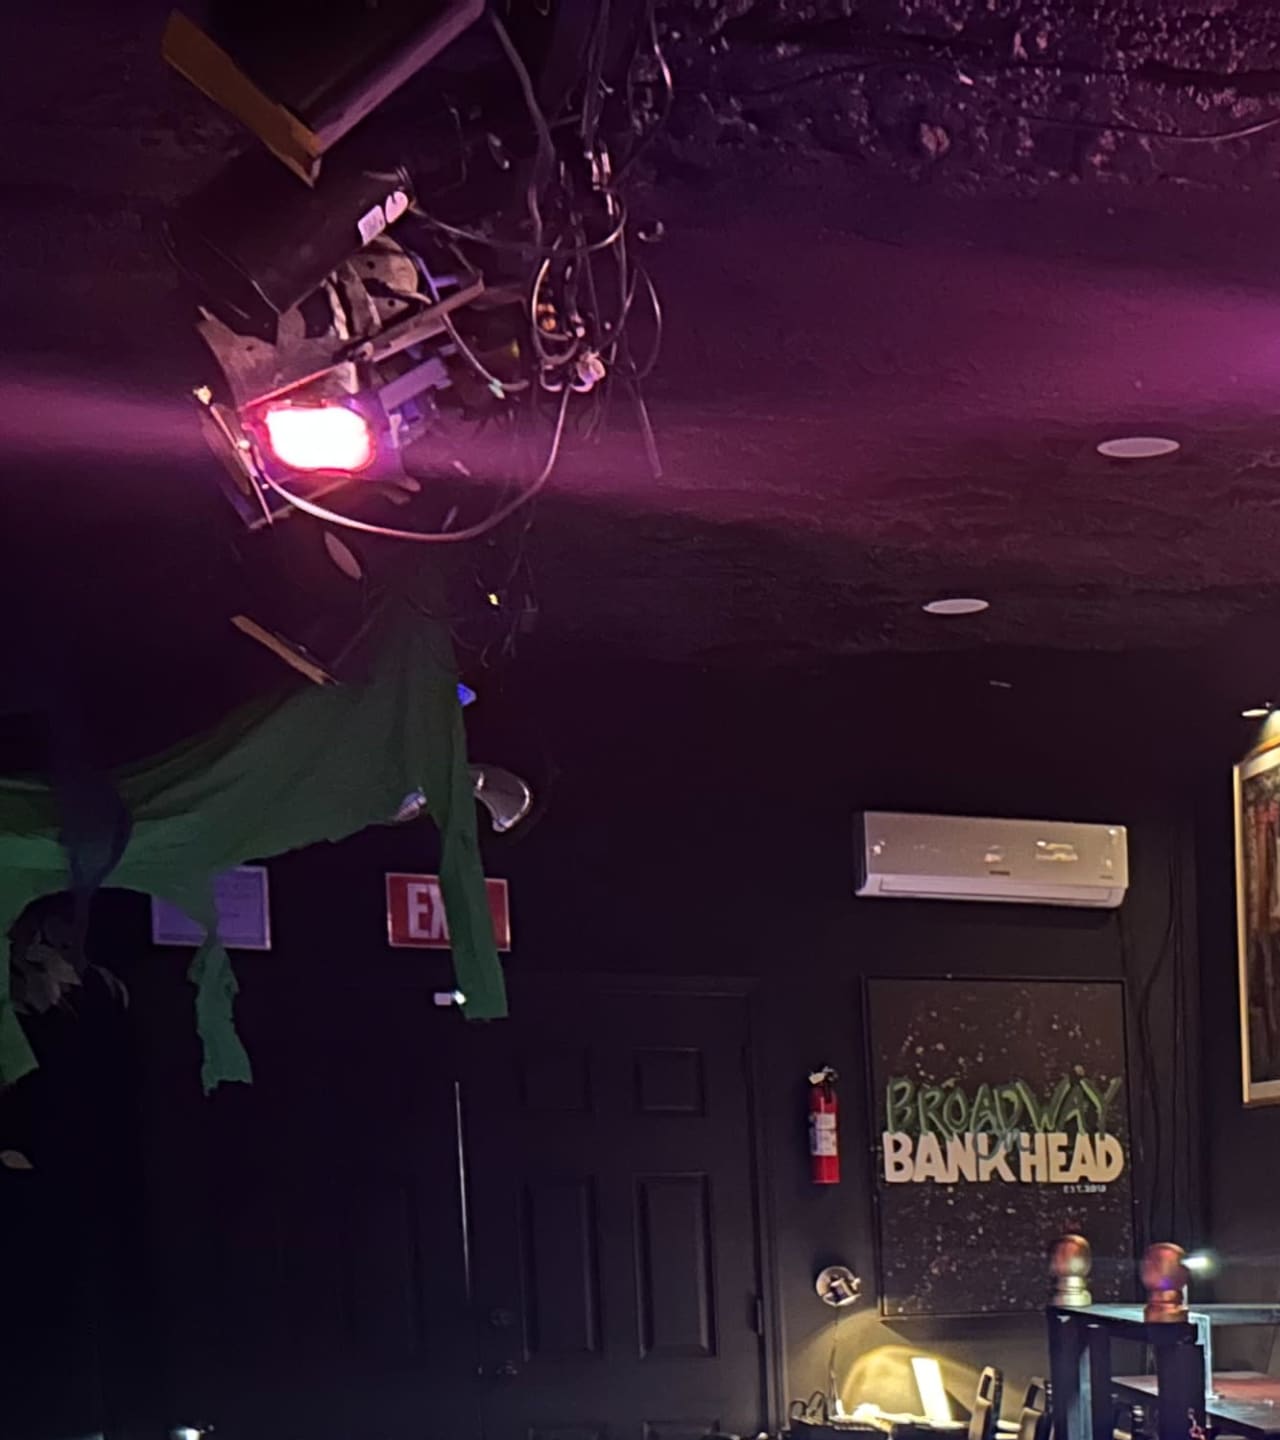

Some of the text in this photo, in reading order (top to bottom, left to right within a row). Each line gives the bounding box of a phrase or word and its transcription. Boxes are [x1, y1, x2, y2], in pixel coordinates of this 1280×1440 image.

[406, 882, 451, 940] EX
[885, 1077, 1122, 1142] BROADWAY
[882, 1131, 1125, 1184] BANKHEAD
